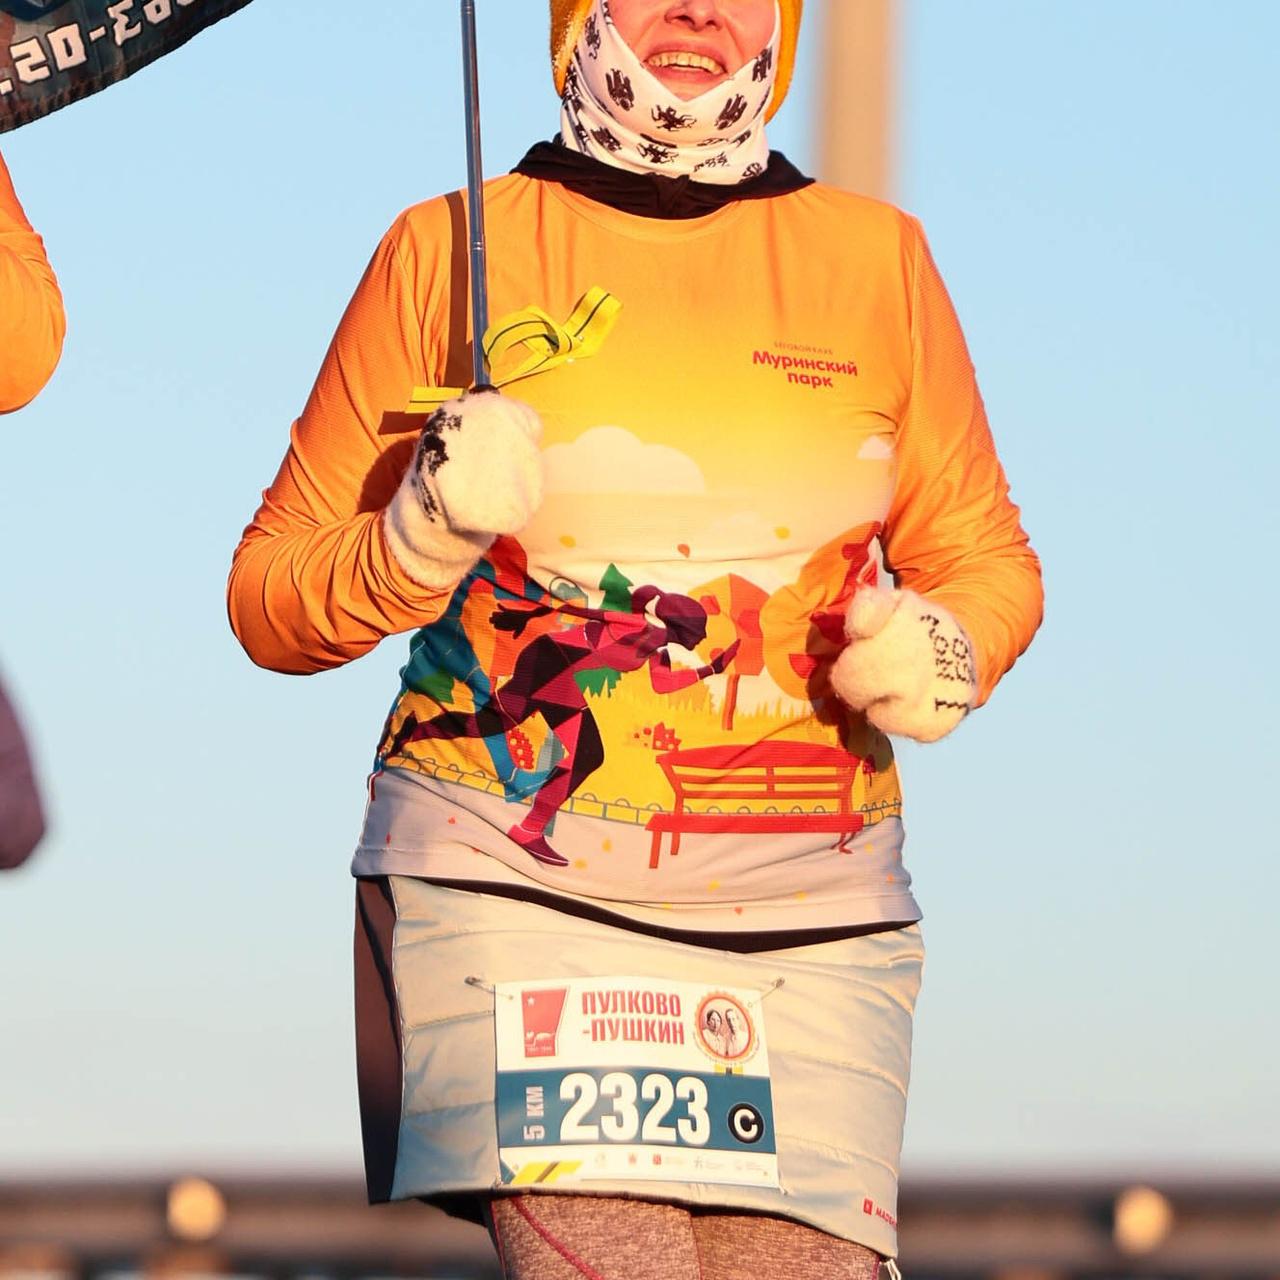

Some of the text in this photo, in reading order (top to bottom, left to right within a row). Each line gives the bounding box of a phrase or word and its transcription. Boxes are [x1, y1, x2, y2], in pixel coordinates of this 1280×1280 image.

[752, 349, 858, 376] Муринский
[786, 372, 833, 389] парк
[581, 990, 682, 1017] ПУЛКОВО
[582, 1017, 685, 1045] -ПУШКИН
[558, 1071, 712, 1146] 2323
[523, 1124, 546, 1141] 5
